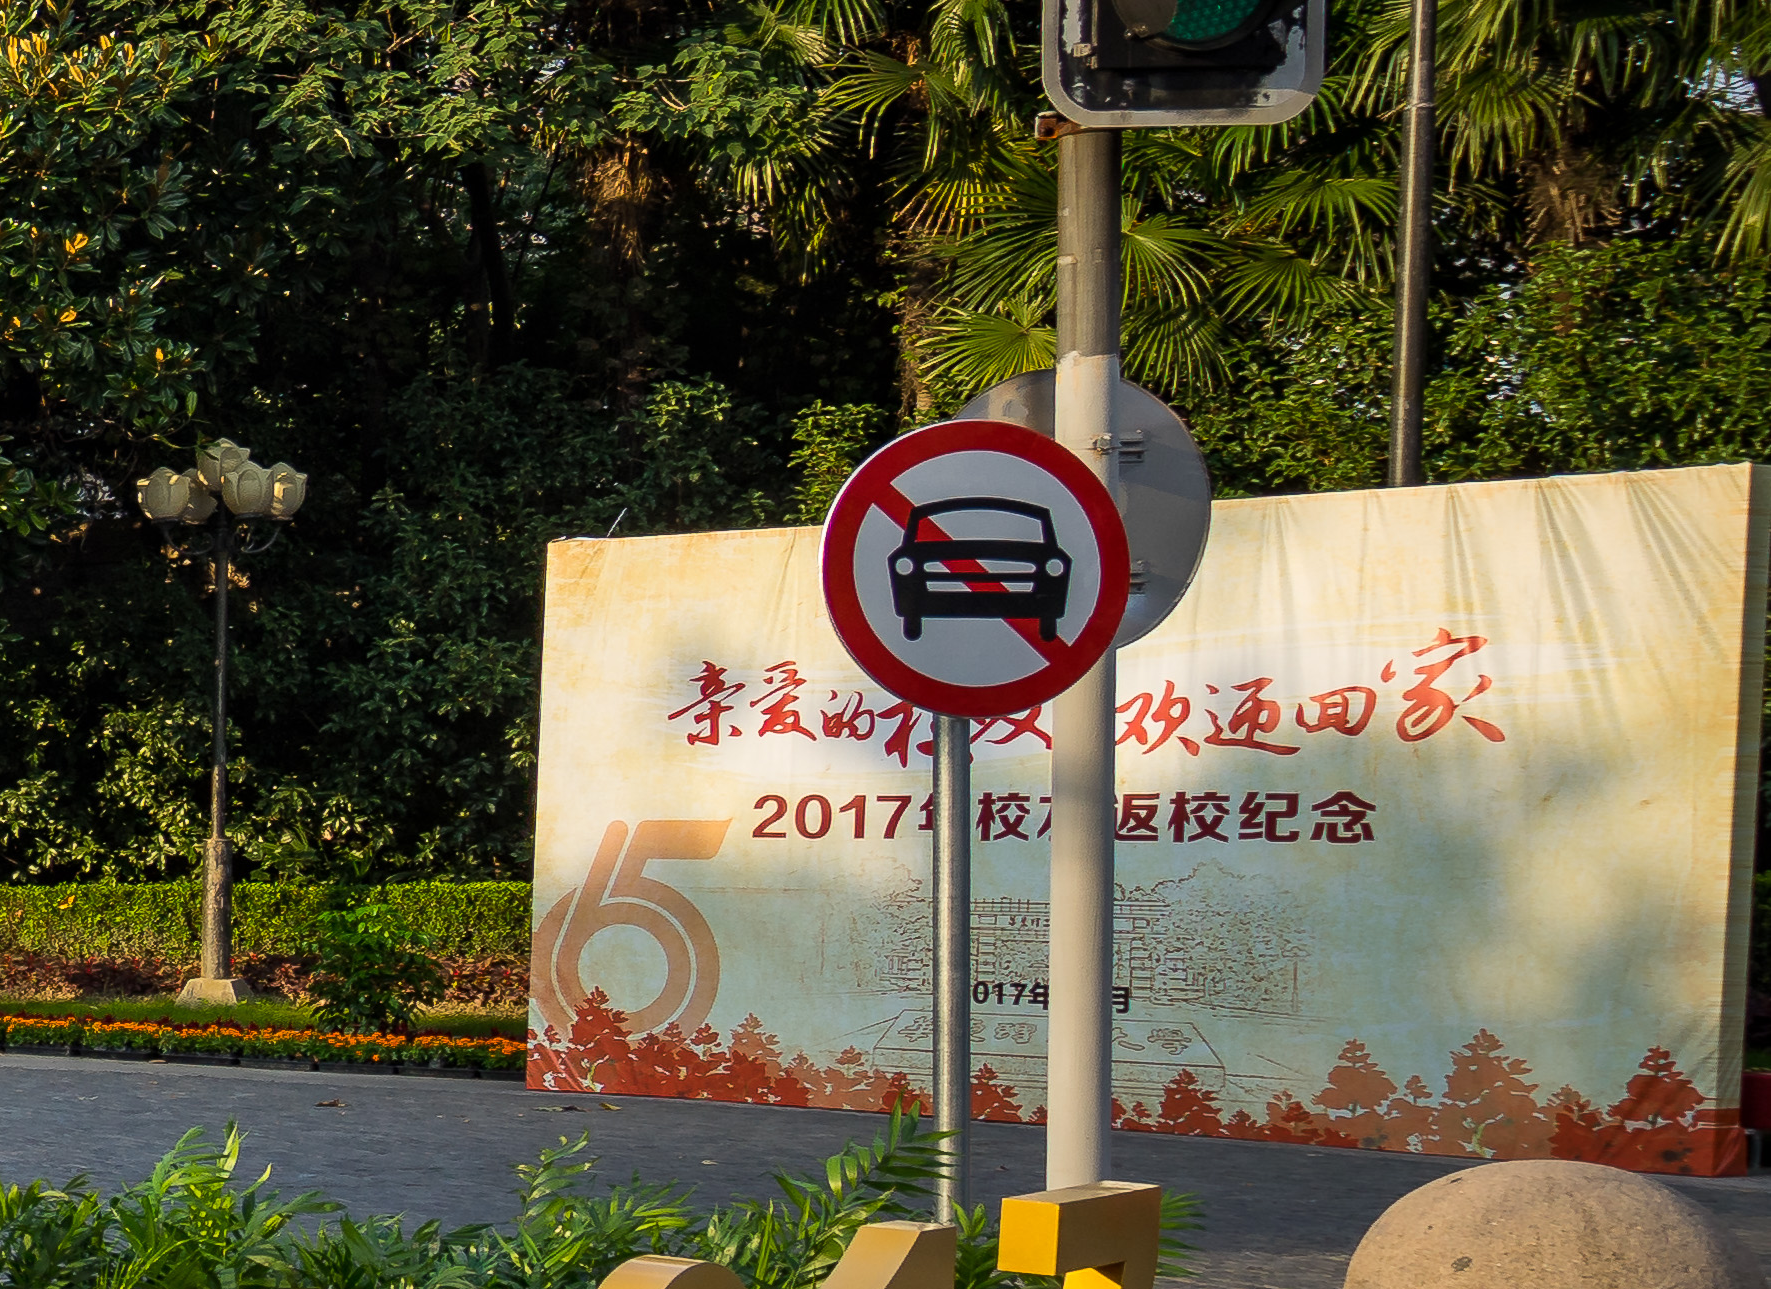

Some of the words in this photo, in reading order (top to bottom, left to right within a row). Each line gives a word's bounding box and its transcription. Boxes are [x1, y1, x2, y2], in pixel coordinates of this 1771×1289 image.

[752, 791, 1377, 843] 2017校返校纪念
